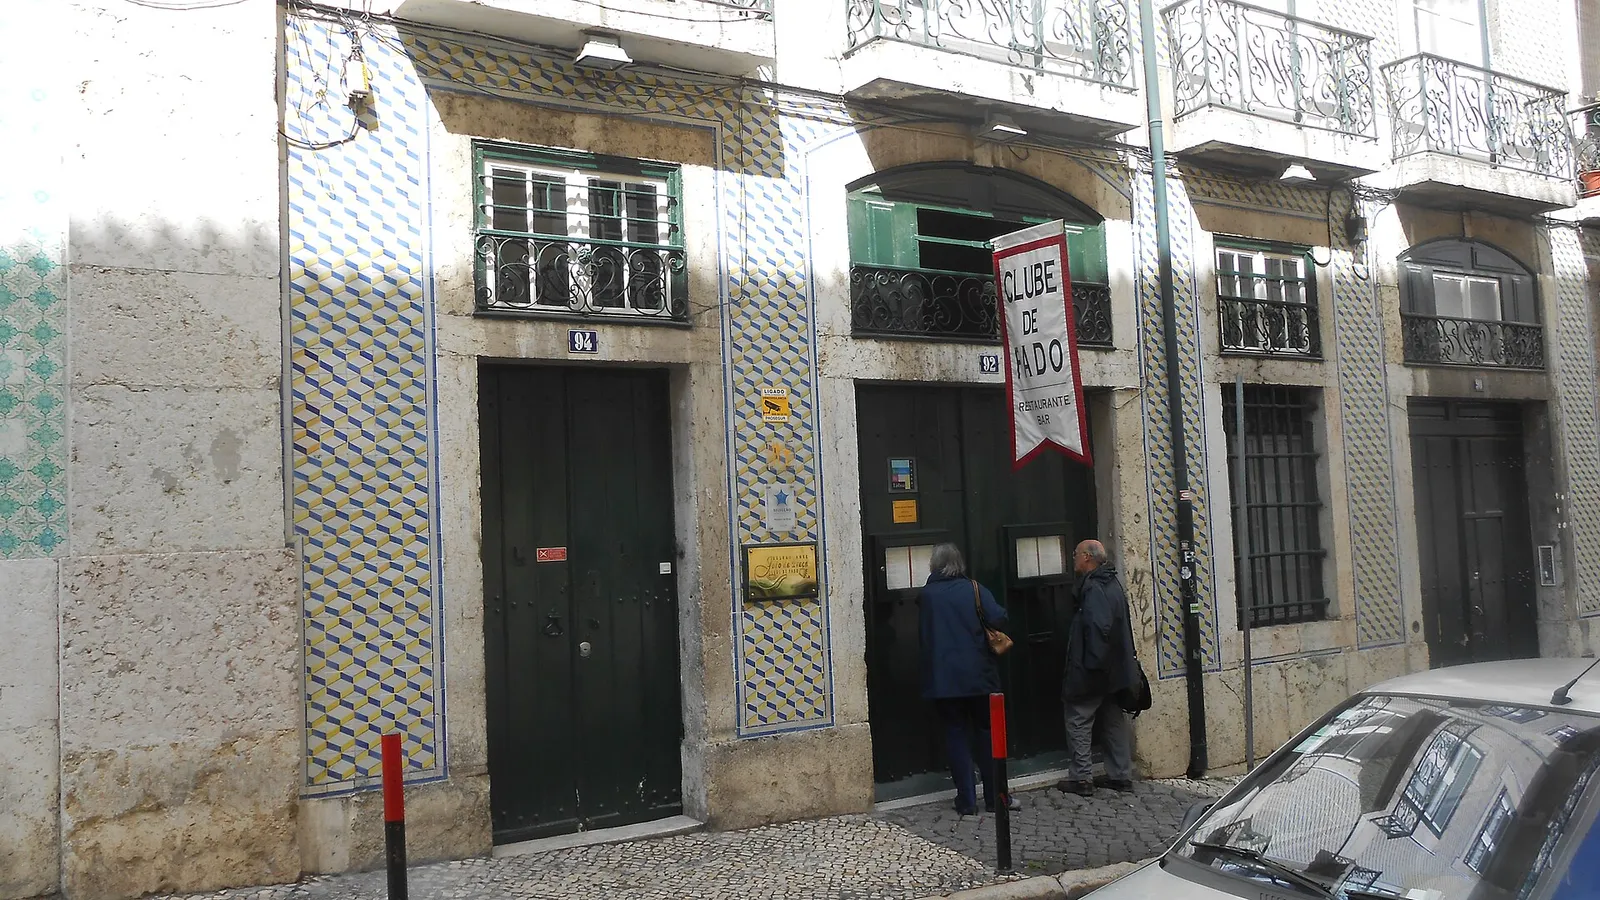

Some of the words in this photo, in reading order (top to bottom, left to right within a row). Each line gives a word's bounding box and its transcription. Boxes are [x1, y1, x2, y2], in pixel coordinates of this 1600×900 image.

[1003, 260, 1057, 303] CLUBE
[1022, 308, 1039, 336] DE
[574, 331, 593, 351] 94
[983, 355, 996, 372] 92
[1014, 339, 1063, 379] FADO
[1018, 394, 1071, 412] RESTAURANTE
[1036, 414, 1051, 426] BAR
